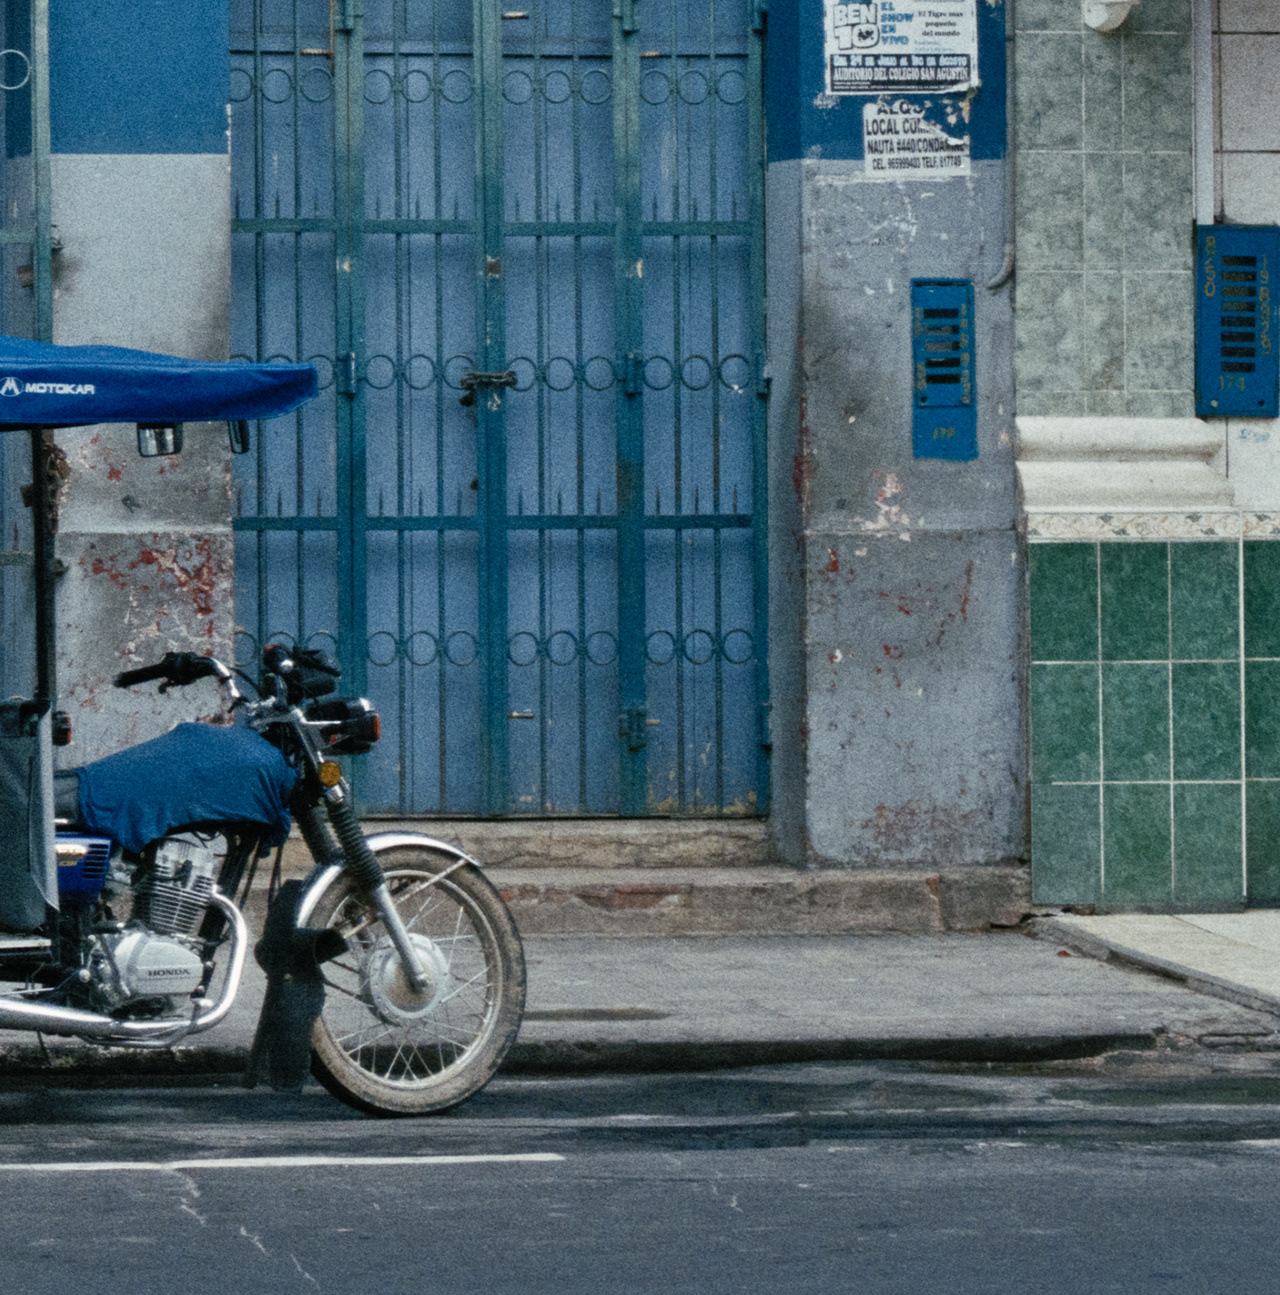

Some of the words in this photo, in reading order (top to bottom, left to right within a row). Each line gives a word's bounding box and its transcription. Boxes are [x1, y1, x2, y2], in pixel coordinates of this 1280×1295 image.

[881, 1, 895, 11] EL
[833, 3, 878, 28] BEN
[928, 11, 947, 19] Tigre
[881, 24, 896, 34] EN
[834, 23, 880, 51] 10
[881, 35, 909, 45] VIVO
[834, 67, 873, 80] AUDITORIO
[874, 68, 888, 80] DEL
[889, 68, 920, 80] COLEGIO
[921, 68, 935, 80] SAN
[866, 118, 899, 136] LOCAL
[867, 140, 894, 154] NAUTA
[872, 158, 886, 170] CEL.
[25, 383, 95, 395] MOTOKAR
[148, 968, 191, 976] HONDA
